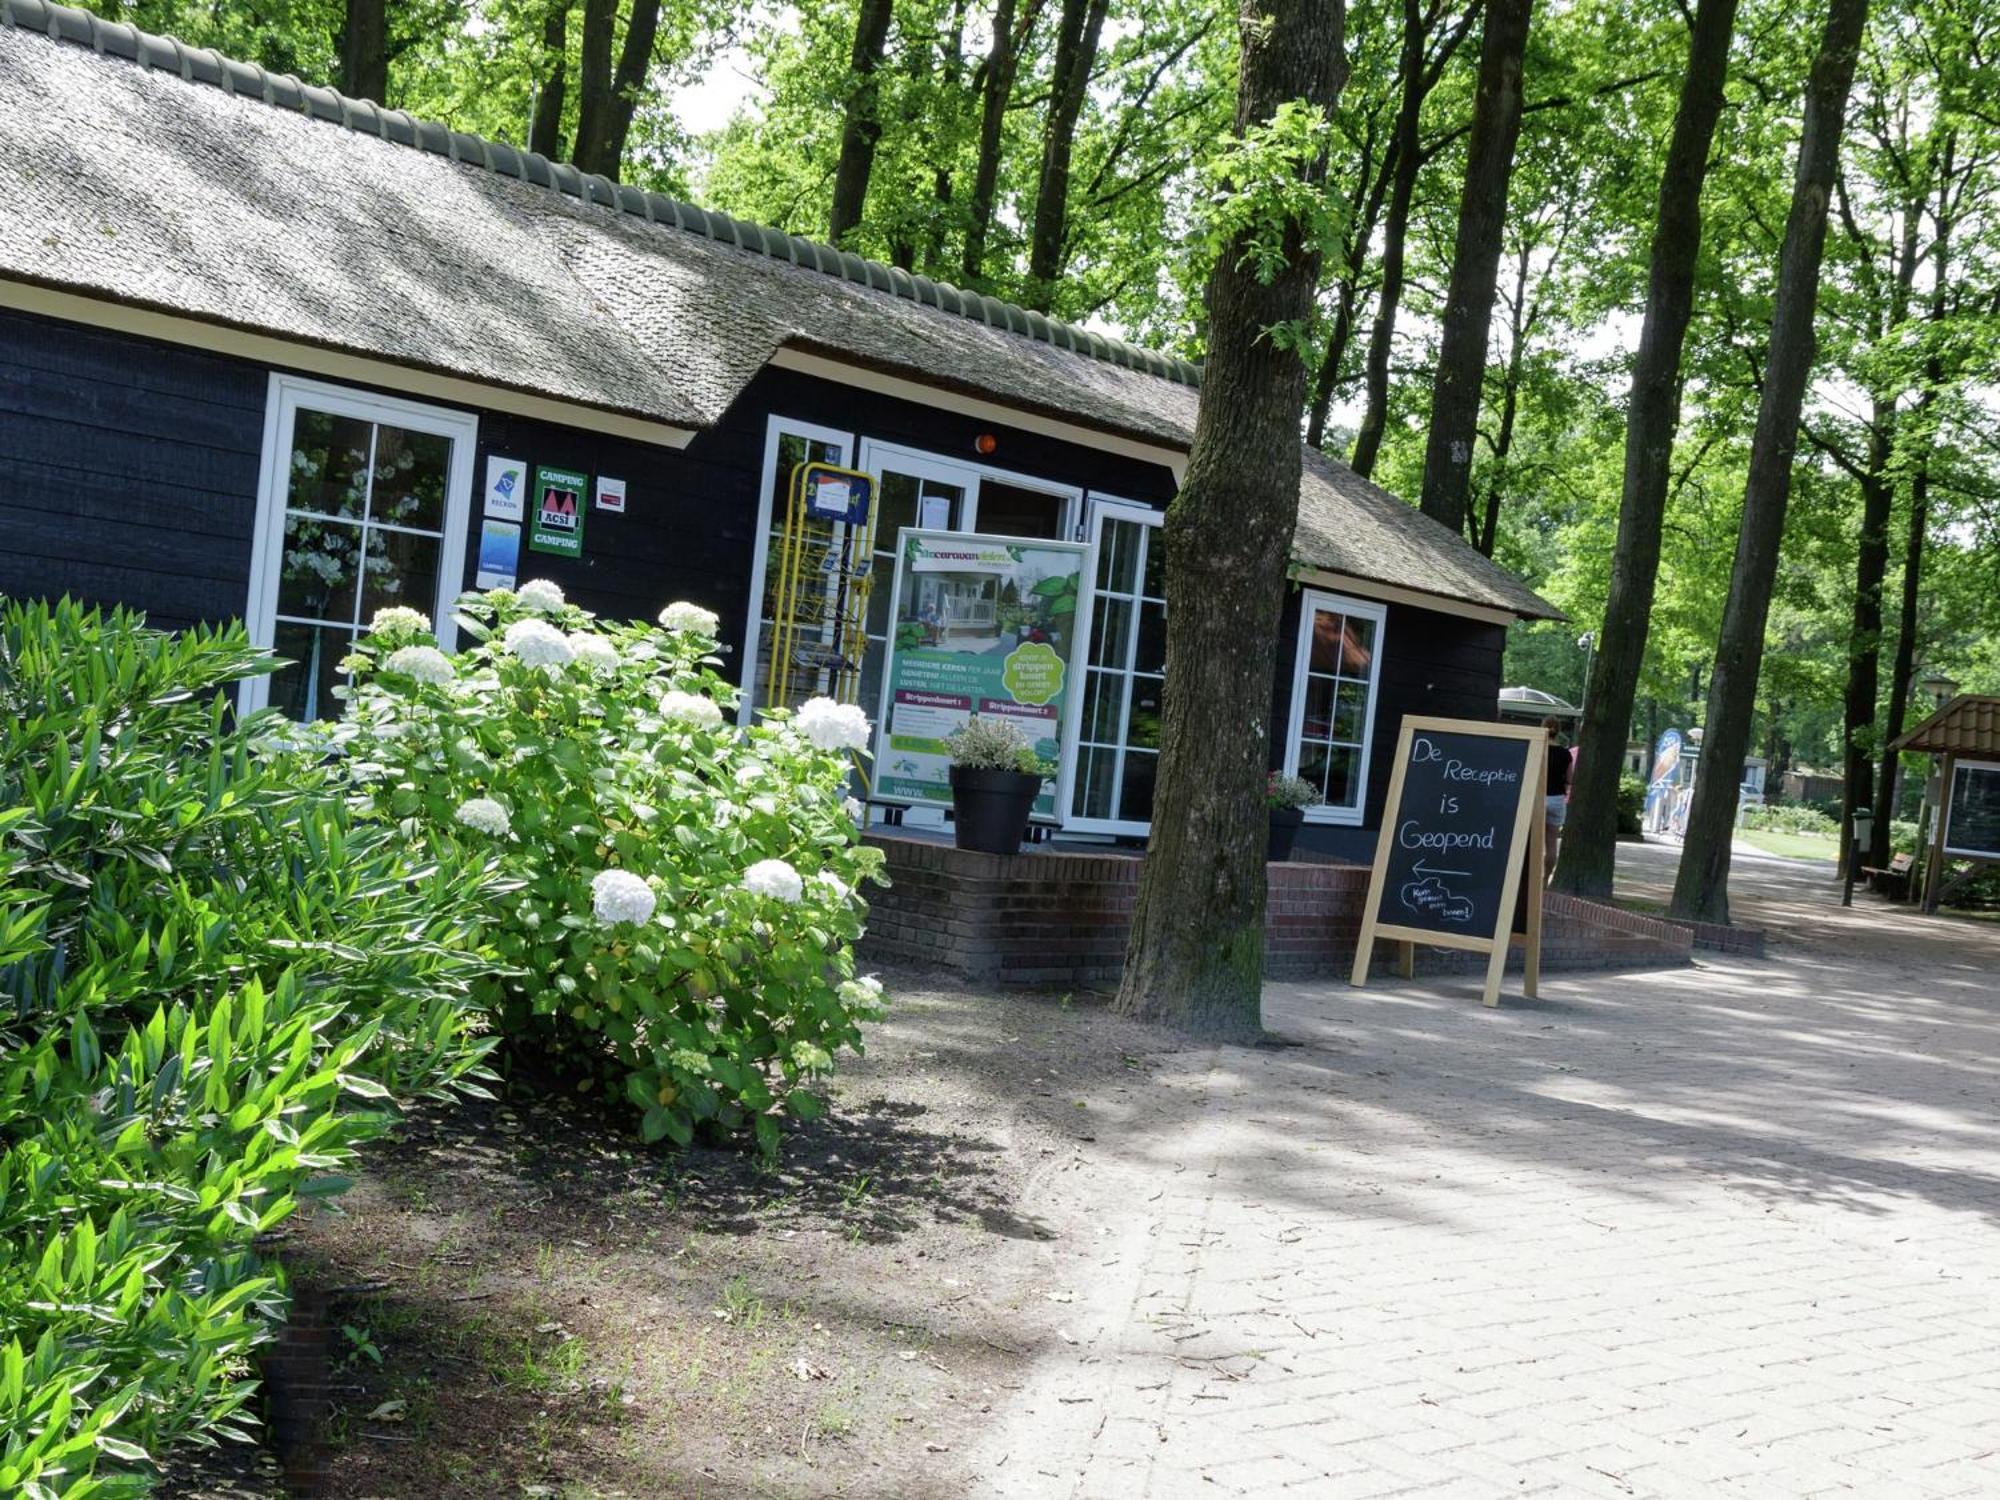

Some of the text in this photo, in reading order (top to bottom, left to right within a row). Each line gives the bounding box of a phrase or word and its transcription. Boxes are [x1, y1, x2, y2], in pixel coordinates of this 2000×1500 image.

[540, 470, 584, 486] CAMPING
[534, 533, 578, 549] CAMPING
[1412, 738, 1443, 762] De
[1443, 759, 1518, 786] Receptie
[1440, 794, 1460, 815] is
[1400, 820, 1495, 854] Geopend
